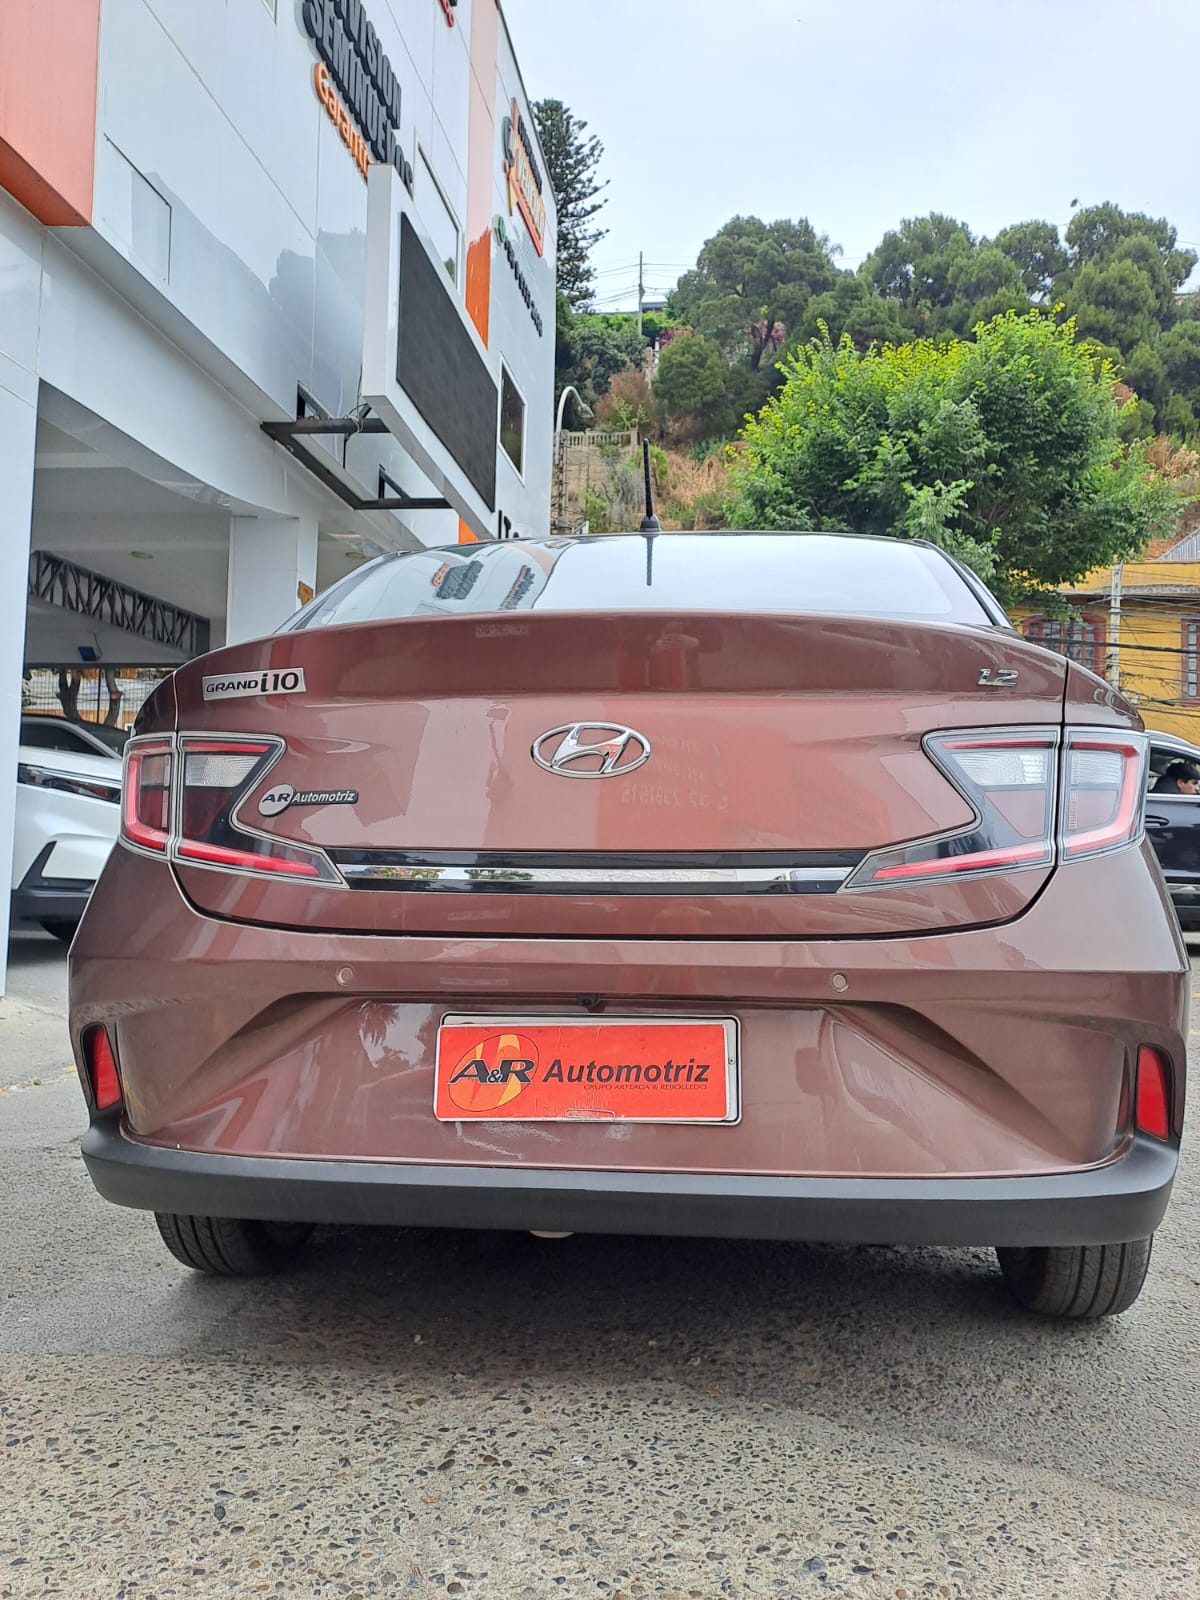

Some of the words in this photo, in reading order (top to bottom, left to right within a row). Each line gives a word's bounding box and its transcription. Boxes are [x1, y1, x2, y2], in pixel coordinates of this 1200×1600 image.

[206, 680, 257, 693] GRAND
[260, 672, 299, 692] i10
[291, 790, 355, 803] Automotriz
[447, 1058, 536, 1085] A&R
[543, 1058, 710, 1084] Automotriz
